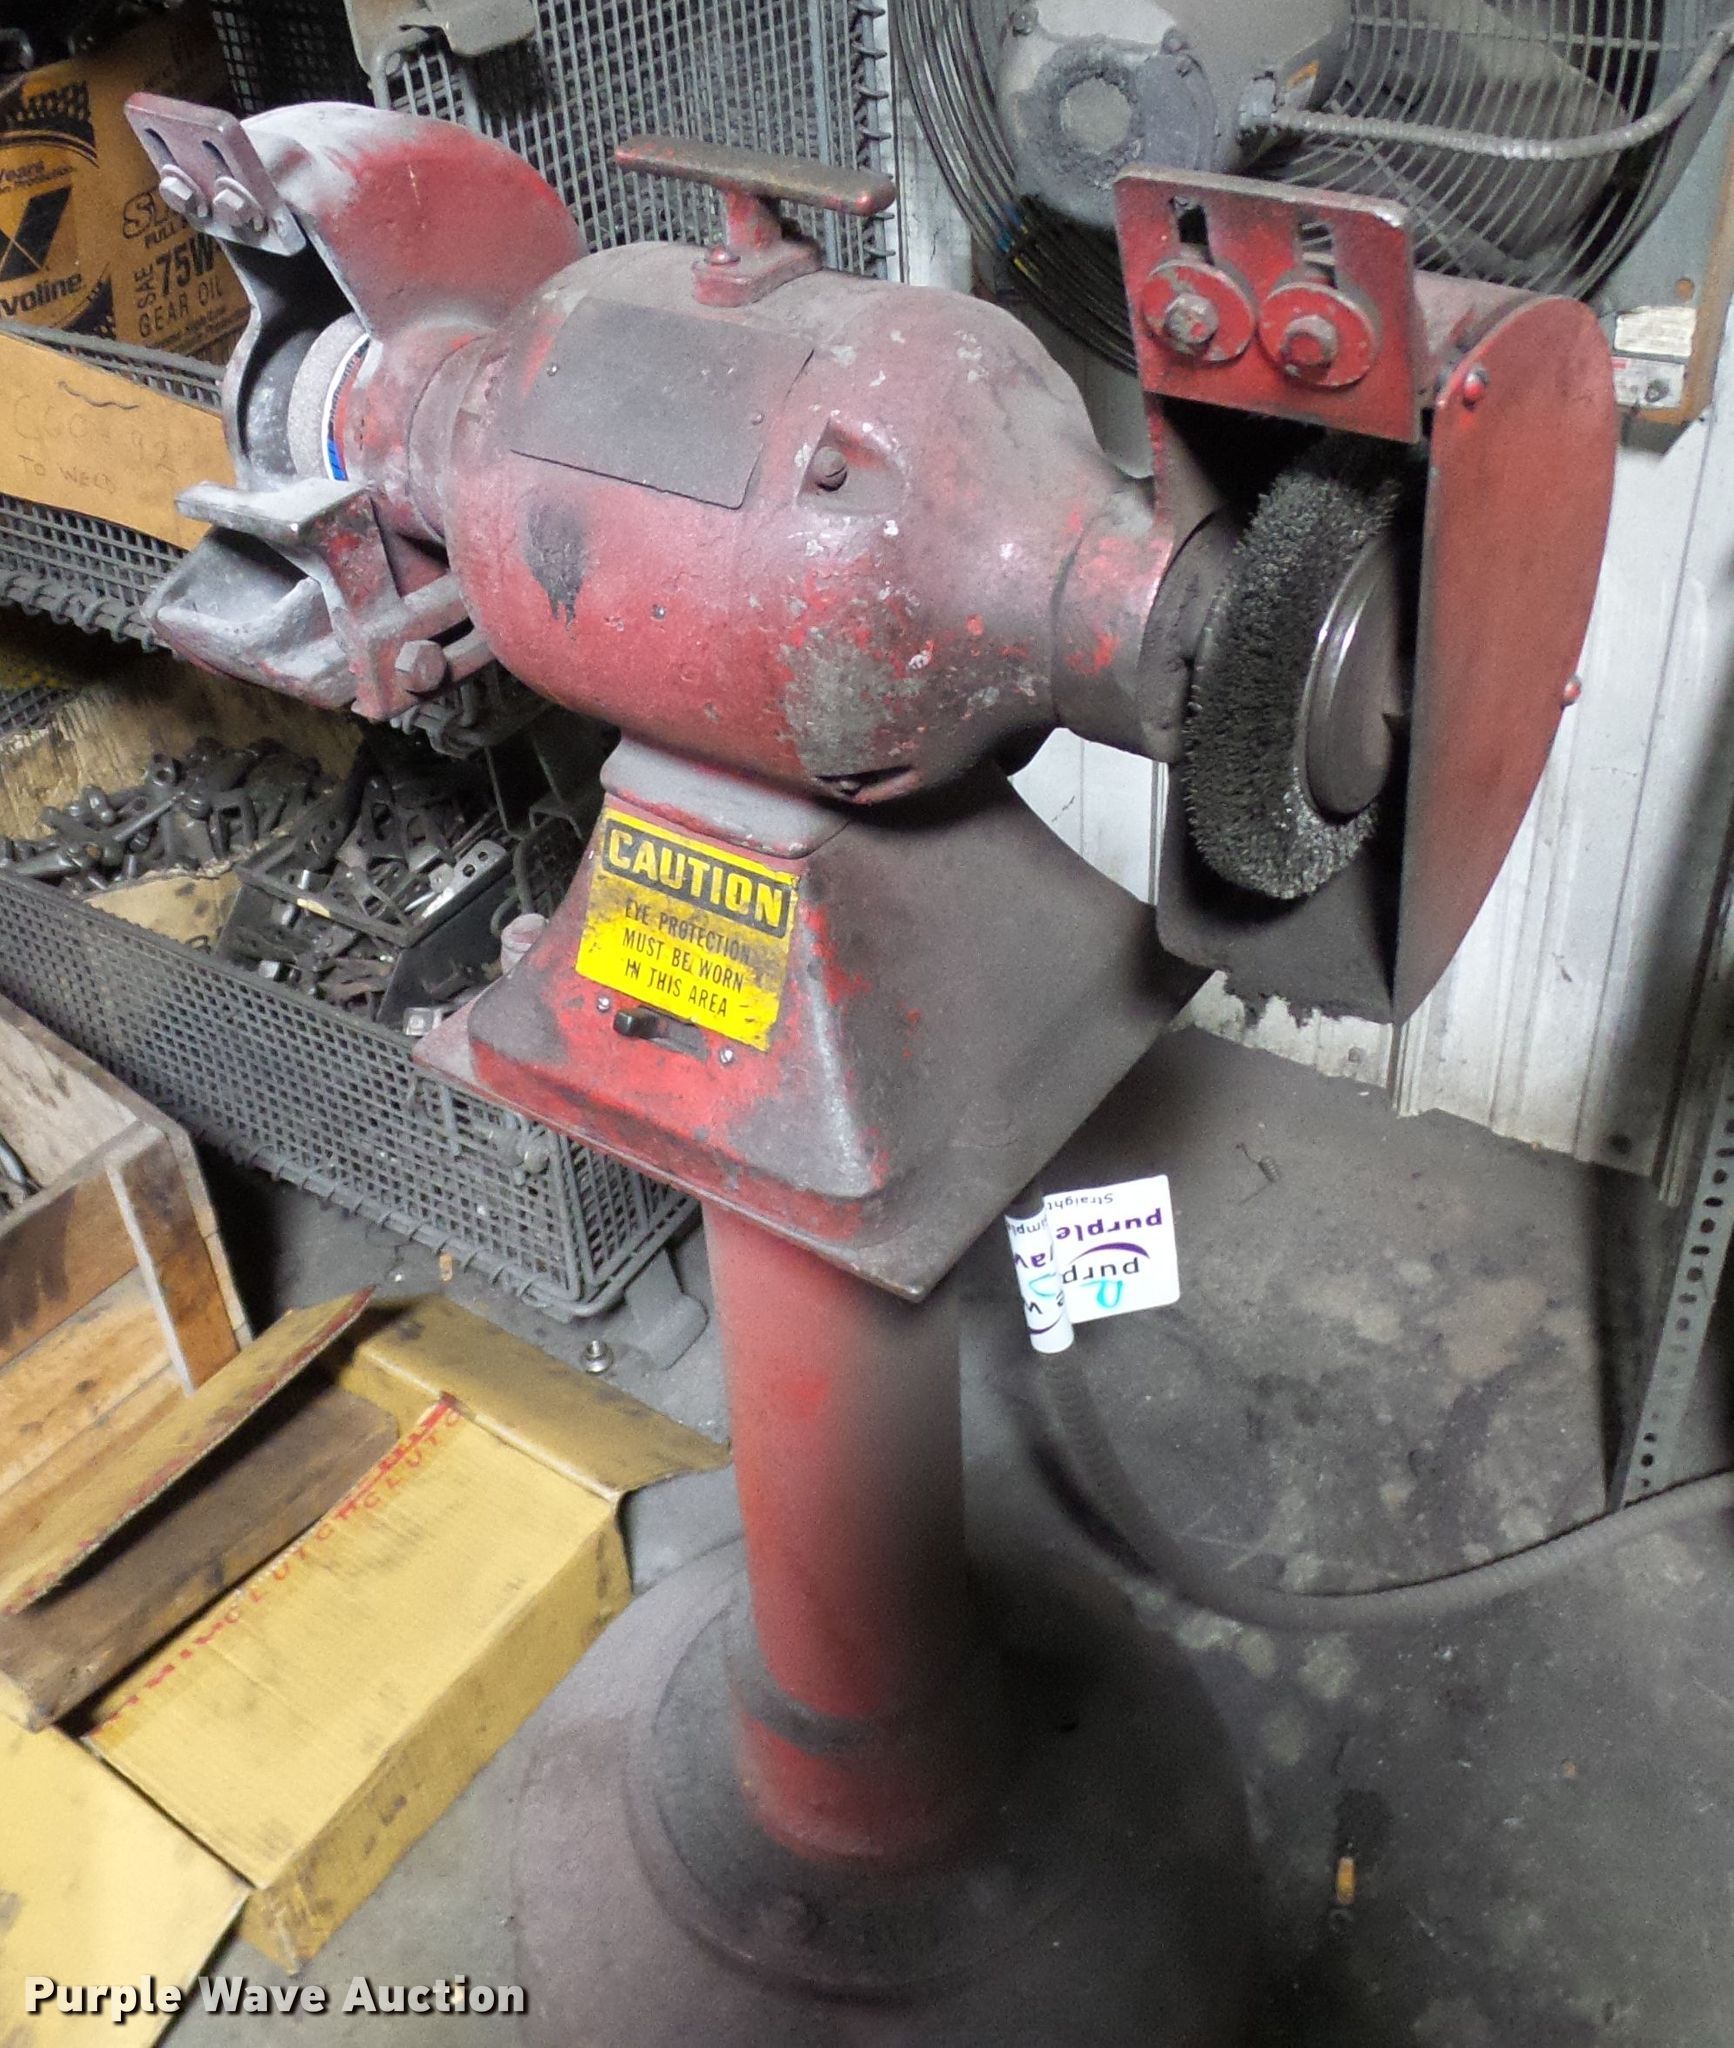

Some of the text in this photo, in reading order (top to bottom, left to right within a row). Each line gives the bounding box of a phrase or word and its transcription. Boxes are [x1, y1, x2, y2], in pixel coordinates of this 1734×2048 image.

[139, 291, 188, 338] GEAR
[199, 274, 222, 307] OIL
[608, 829, 784, 928] CAUTION
[621, 927, 744, 994] MUST BE WORN
[625, 900, 751, 965] EYE PROTECTION
[625, 957, 729, 1018] IN THIS AREA
[1048, 1192, 1114, 1210] Straight
[1055, 1207, 1163, 1241] purple
